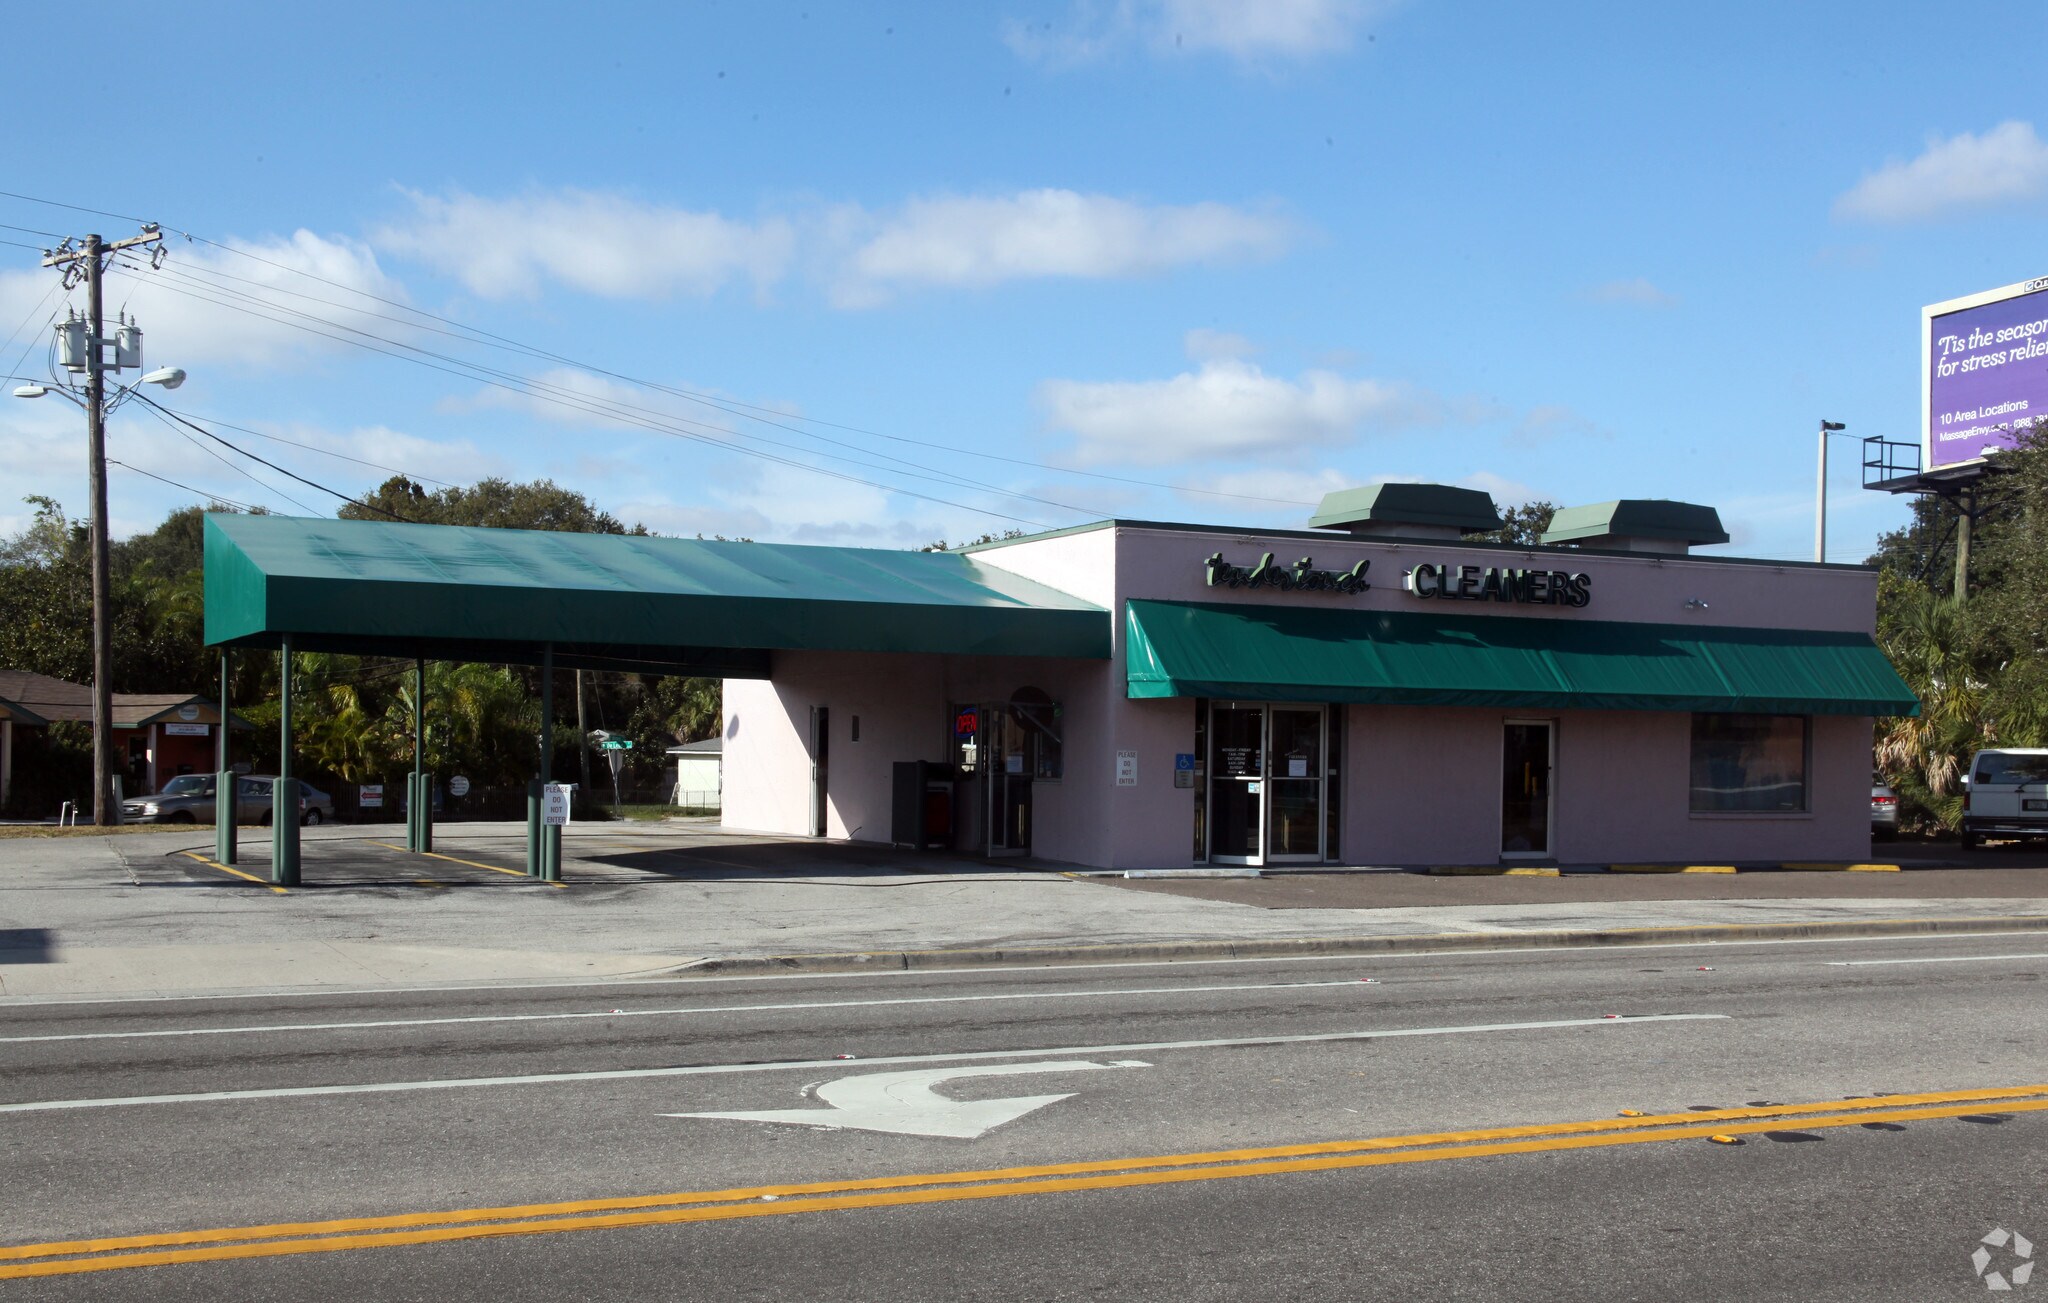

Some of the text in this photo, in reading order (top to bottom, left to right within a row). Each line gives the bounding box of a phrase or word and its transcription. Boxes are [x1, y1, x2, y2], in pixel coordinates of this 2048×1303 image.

[1968, 327, 1994, 350] the
[1937, 337, 2048, 378] for stress relie
[1940, 400, 2029, 425] 10 Area Locations
[1411, 563, 1592, 608] CLEANERS
[957, 713, 977, 734] OPEN
[1117, 751, 1136, 759] PLEASE
[545, 786, 569, 794] PLEASE
[552, 796, 562, 804] DO
[550, 806, 562, 814] NOT
[546, 816, 567, 824] ENTER
